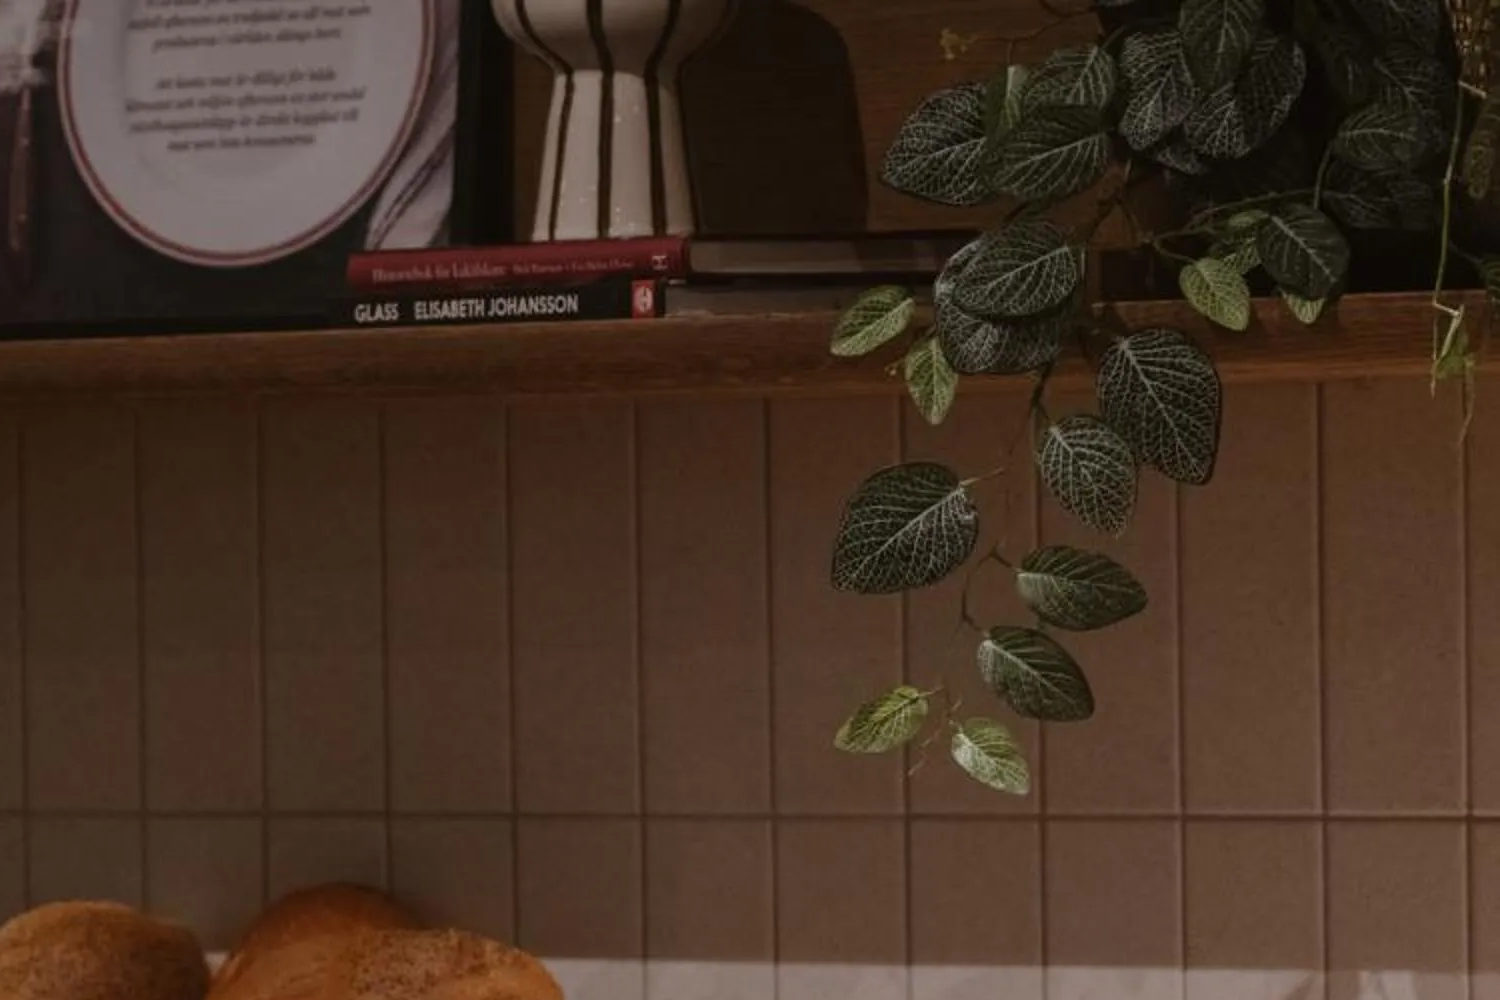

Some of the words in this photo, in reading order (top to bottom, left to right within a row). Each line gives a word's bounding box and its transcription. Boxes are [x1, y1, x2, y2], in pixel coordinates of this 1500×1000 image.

[354, 303, 399, 322] GLASS
[414, 298, 484, 319] ELISABETH
[487, 293, 578, 316] JOHANSSON
